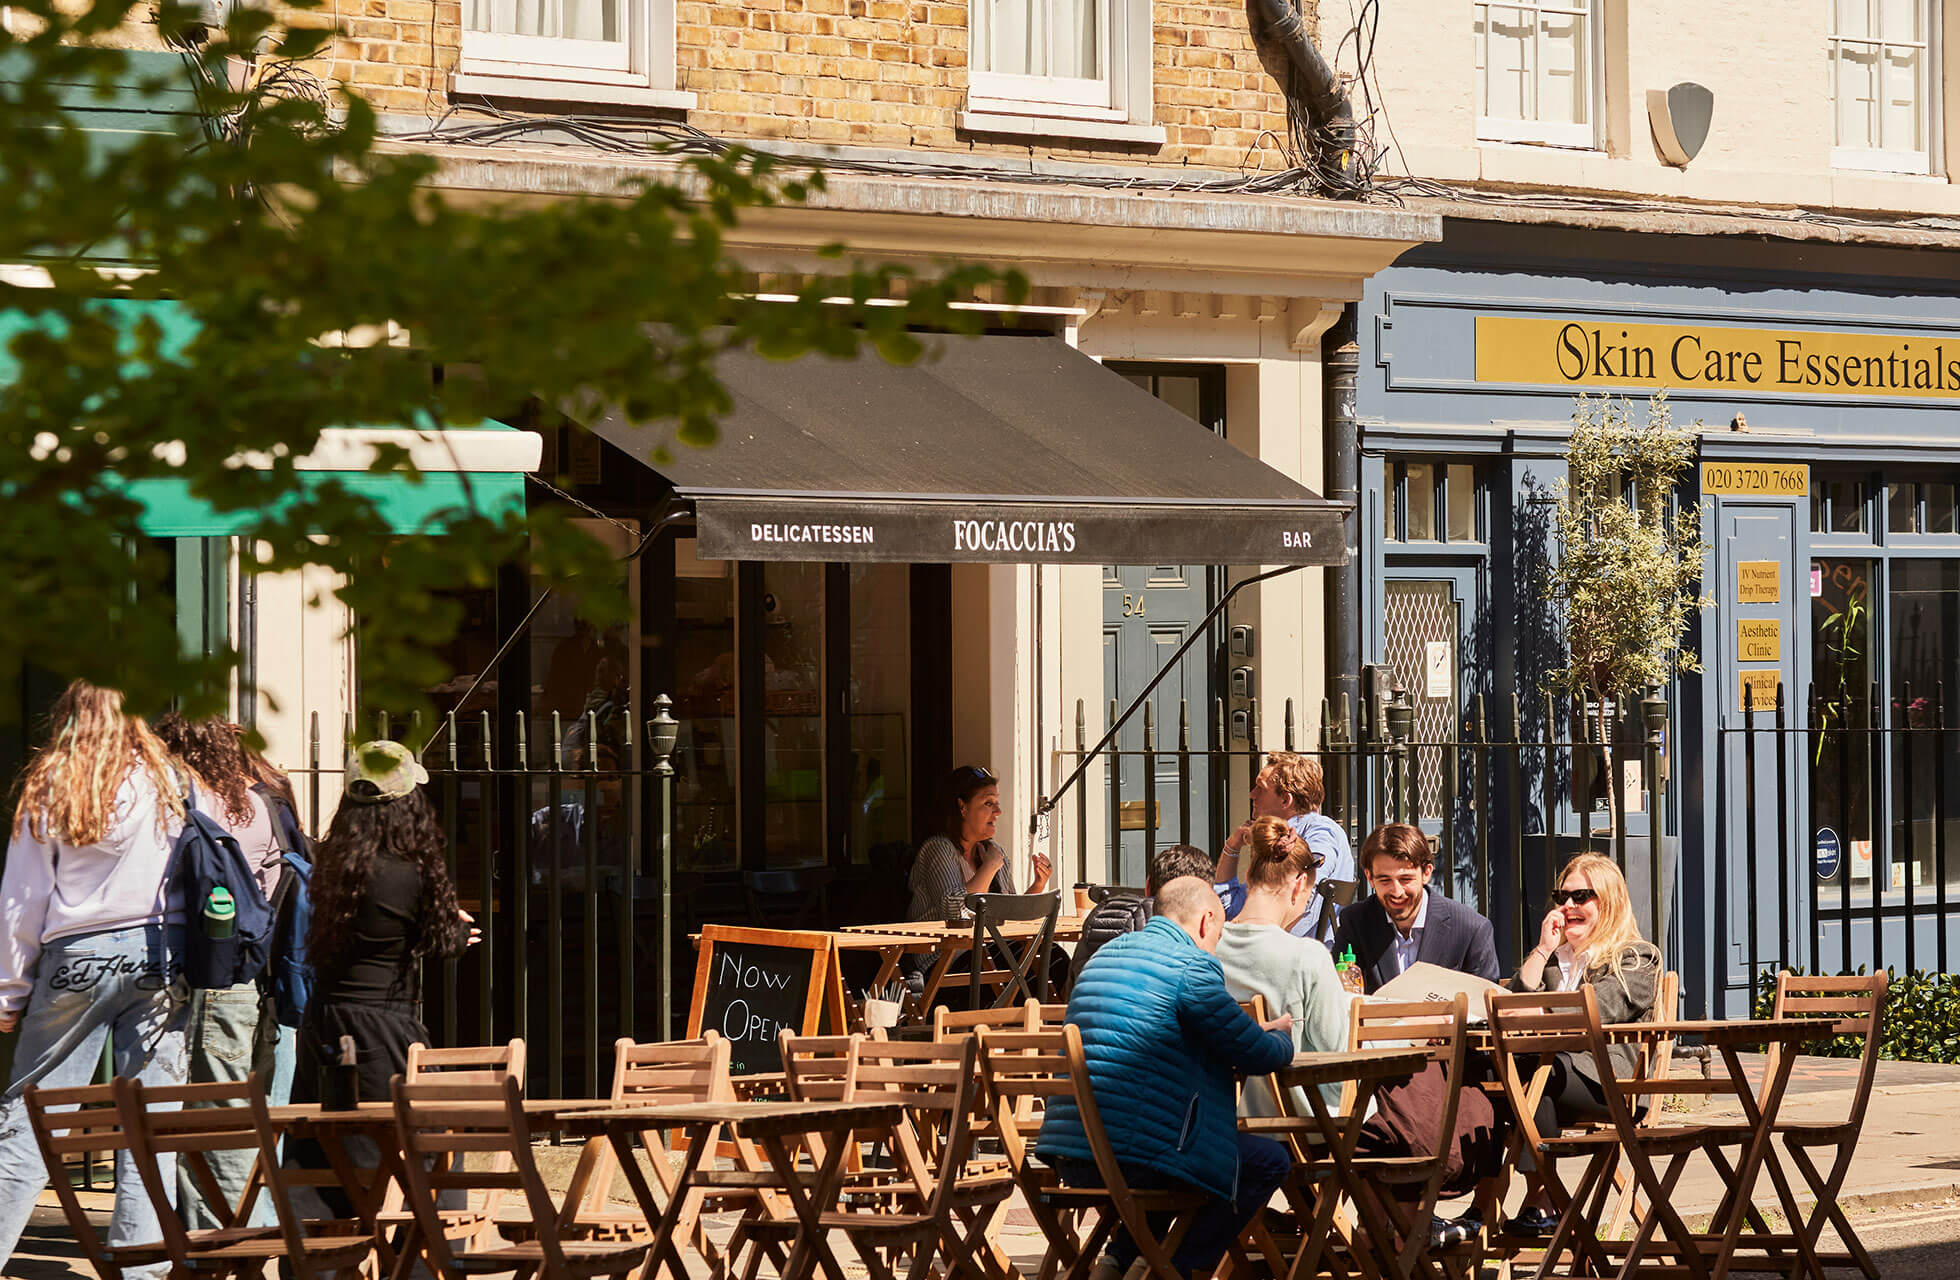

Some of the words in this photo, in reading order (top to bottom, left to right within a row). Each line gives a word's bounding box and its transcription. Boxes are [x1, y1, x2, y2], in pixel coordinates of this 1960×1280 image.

[1556, 323, 1656, 381] Skin
[1671, 335, 1762, 383] Care
[1776, 340, 1960, 391] Essentials
[1707, 469, 1732, 489] 020
[1736, 469, 1769, 489] 3720
[1773, 470, 1804, 490] 7668
[751, 524, 874, 543] DELICATESSEN
[953, 520, 1076, 552] FOCACCIA'S
[1282, 531, 1313, 548] BAR
[1742, 569, 1750, 579] IV
[1740, 584, 1753, 597] Drip
[1755, 584, 1778, 597] Therapy
[1123, 594, 1145, 617] 54
[1741, 624, 1778, 638] Aesthetic
[1747, 643, 1772, 657] Clinic
[1744, 675, 1776, 690] Clinical
[1744, 692, 1777, 707] rvices
